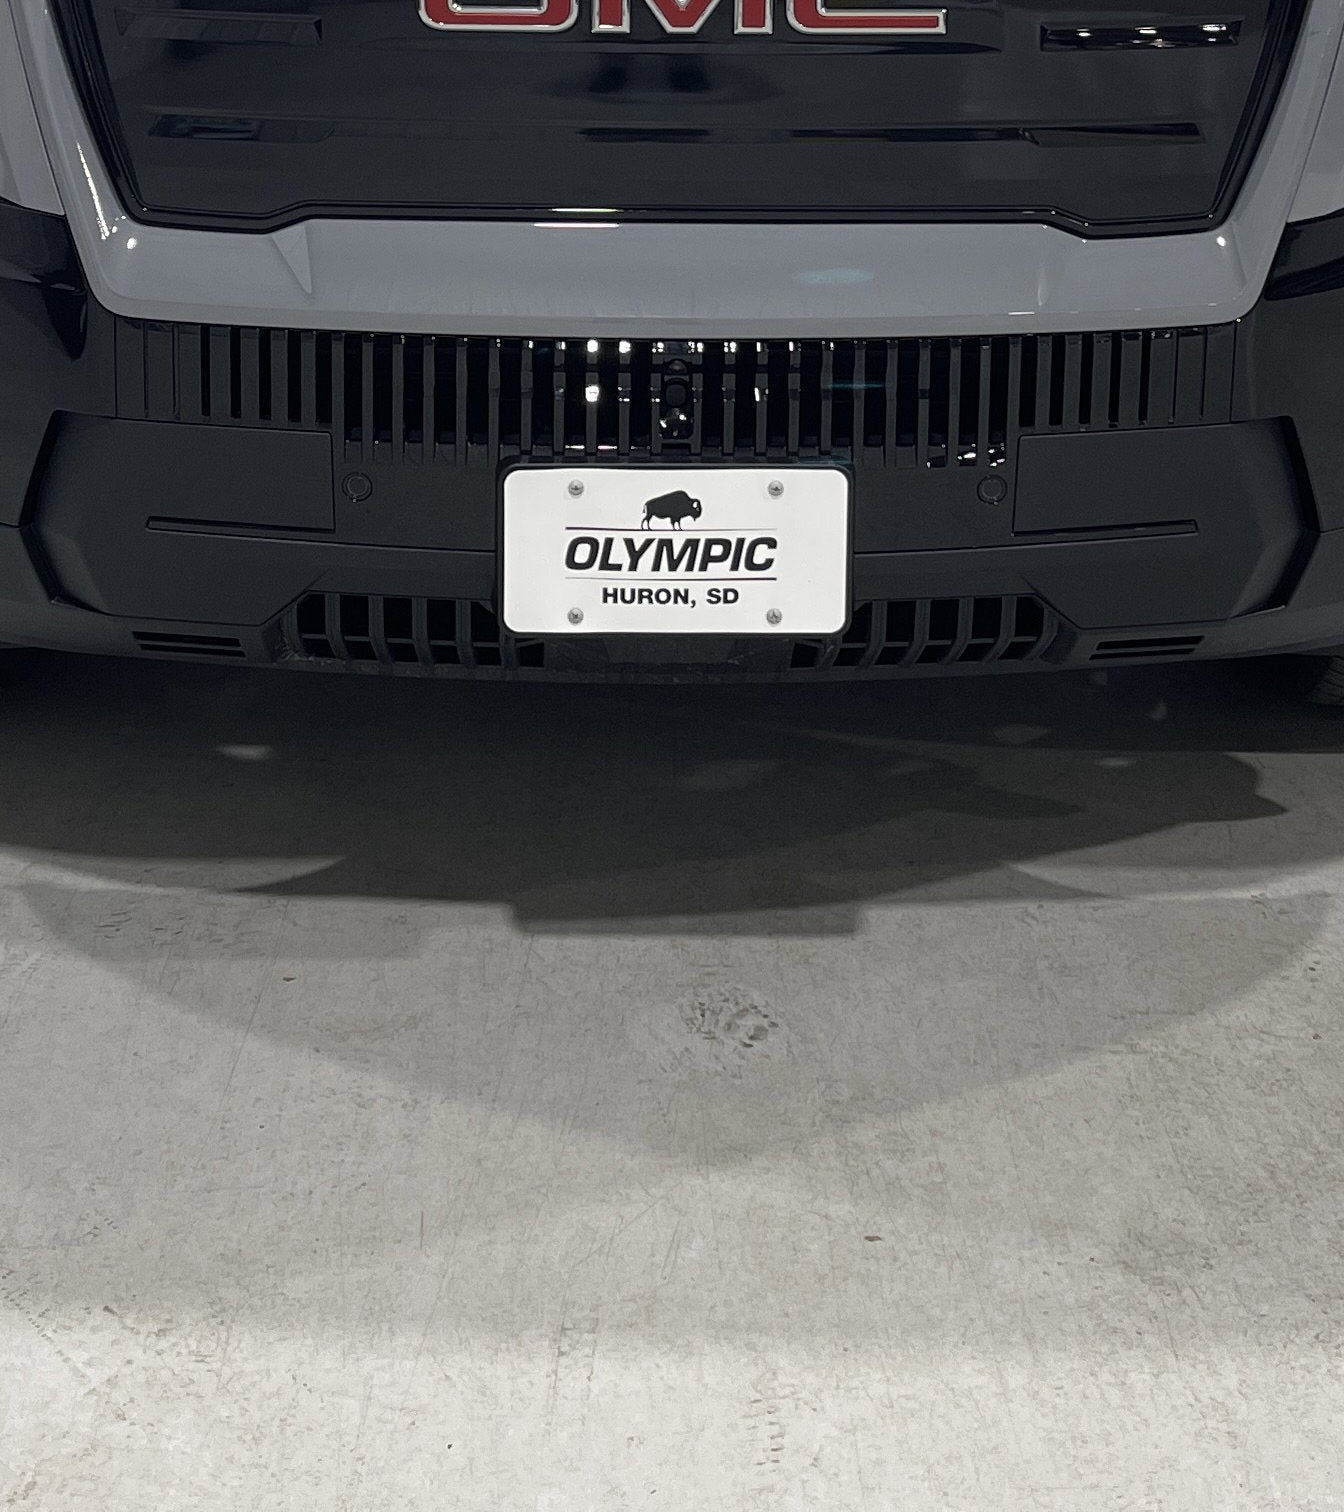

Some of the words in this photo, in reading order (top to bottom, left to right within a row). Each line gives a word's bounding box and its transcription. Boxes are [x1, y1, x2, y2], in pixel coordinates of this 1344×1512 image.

[564, 536, 778, 573] OLYMPIC
[602, 587, 696, 608] HURON,
[706, 588, 740, 605] SD
